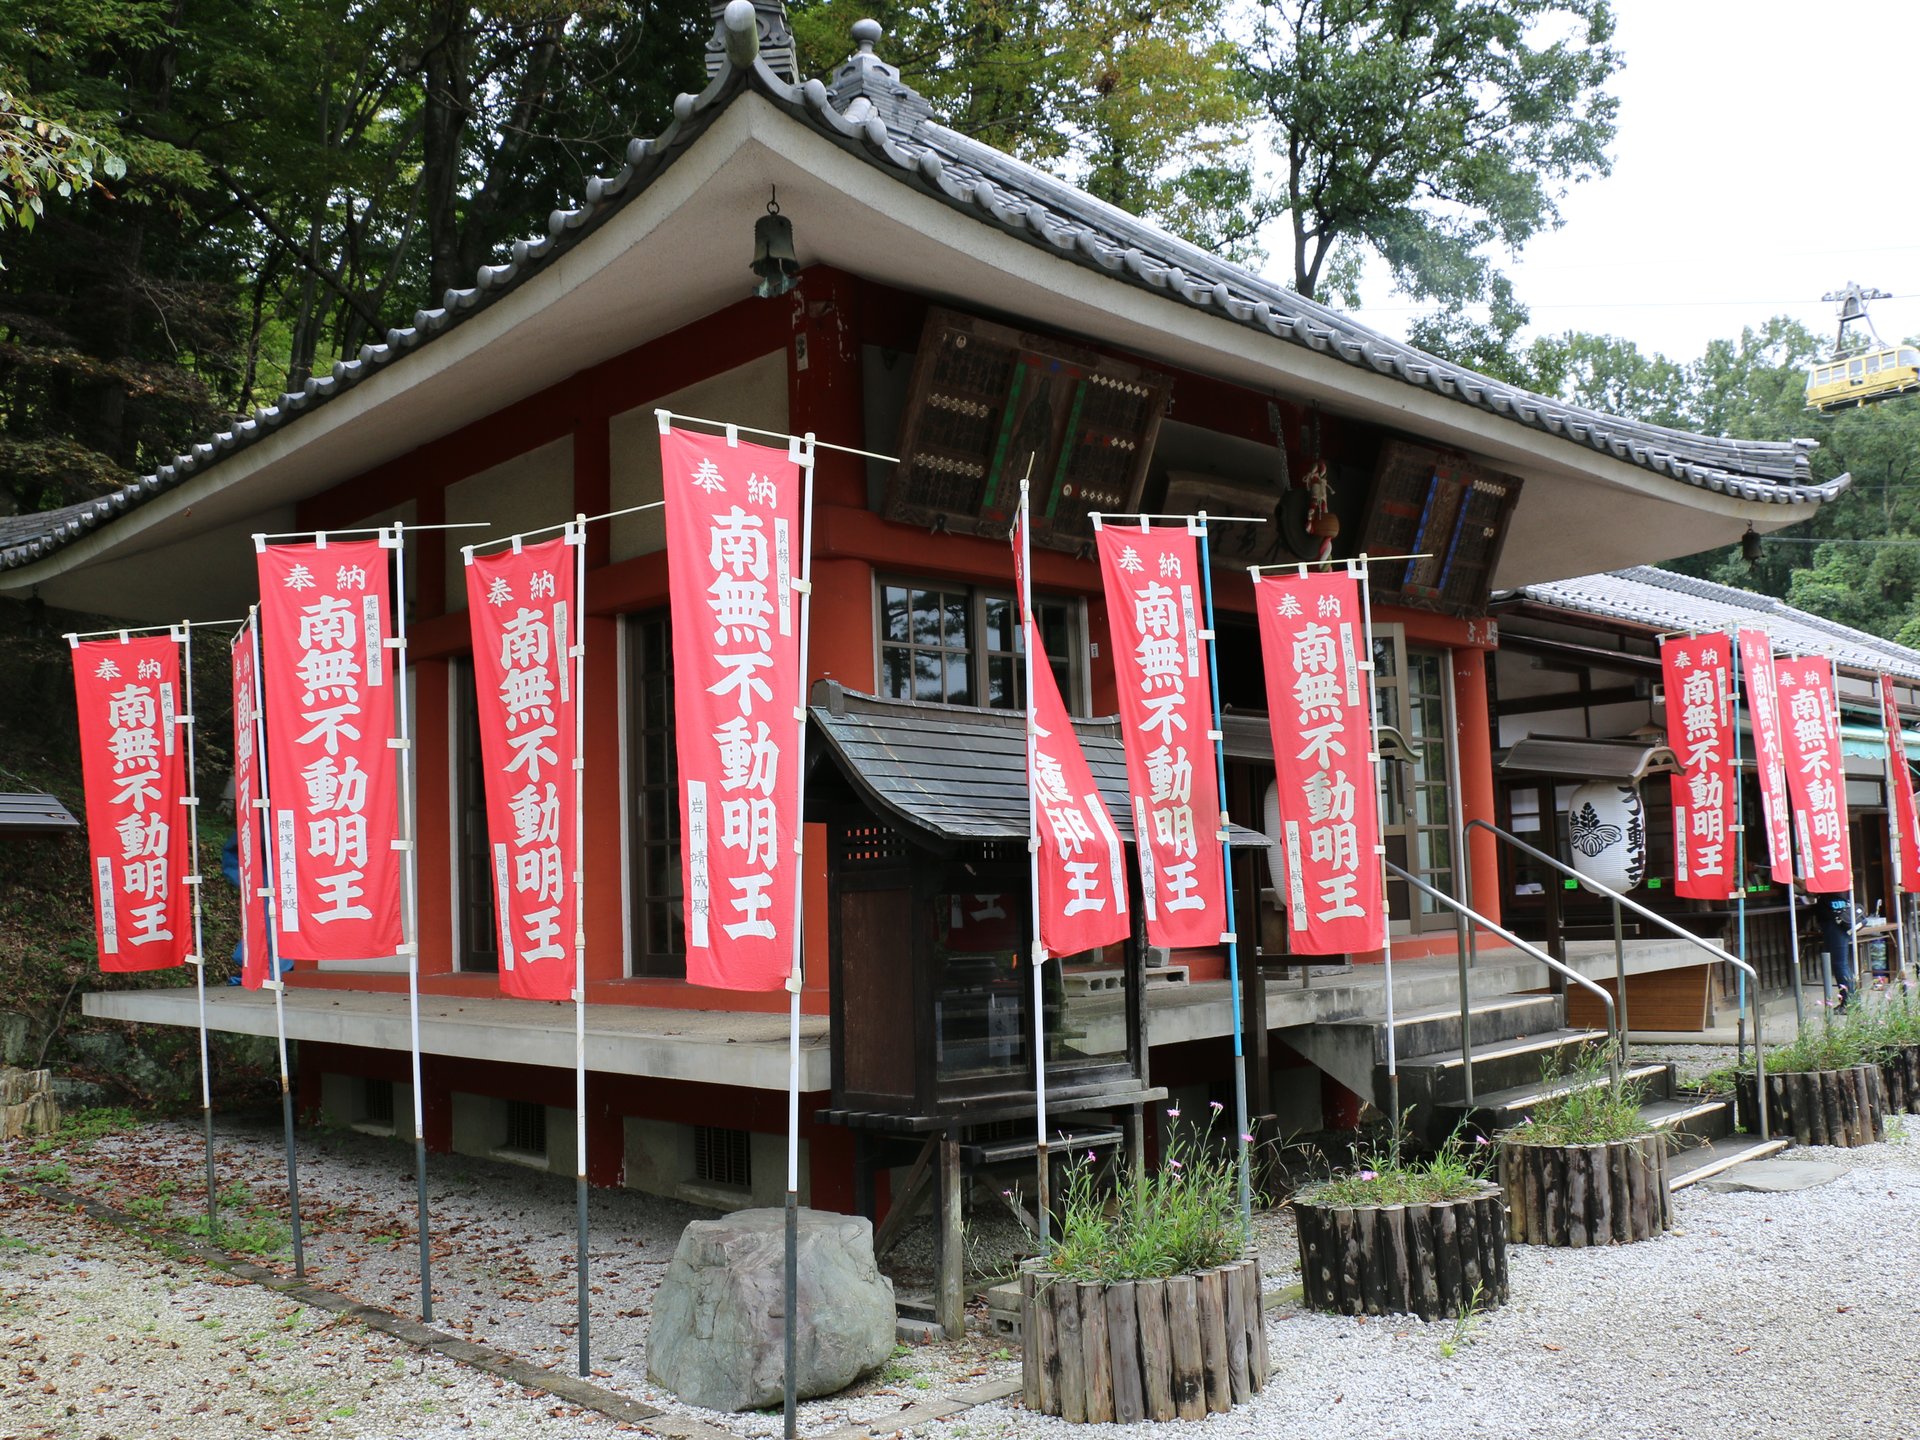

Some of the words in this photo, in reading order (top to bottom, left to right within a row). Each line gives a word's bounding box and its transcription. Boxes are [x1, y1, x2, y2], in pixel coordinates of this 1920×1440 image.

[690, 457, 778, 510] 奉納
[283, 563, 366, 592] 奉納
[487, 569, 555, 607] 奉納
[1118, 545, 1182, 580] 奉納
[1182, 592, 1199, 658] 心願成就
[1277, 592, 1342, 619] 奉納
[95, 658, 161, 681] 奉納
[1674, 648, 1719, 668] 奉納
[1779, 670, 1821, 688] 奉納
[706, 504, 781, 941] 南無不動明王
[1134, 580, 1206, 914] 南無不動明王
[294, 595, 373, 924] 南無不動明王
[499, 607, 566, 964] 南無不動明王
[1292, 621, 1366, 923] 南無不動明王
[1682, 669, 1725, 877] 南無不動明王
[1790, 687, 1845, 874] 南無不動明王
[106, 683, 173, 946] 南無不動明王
